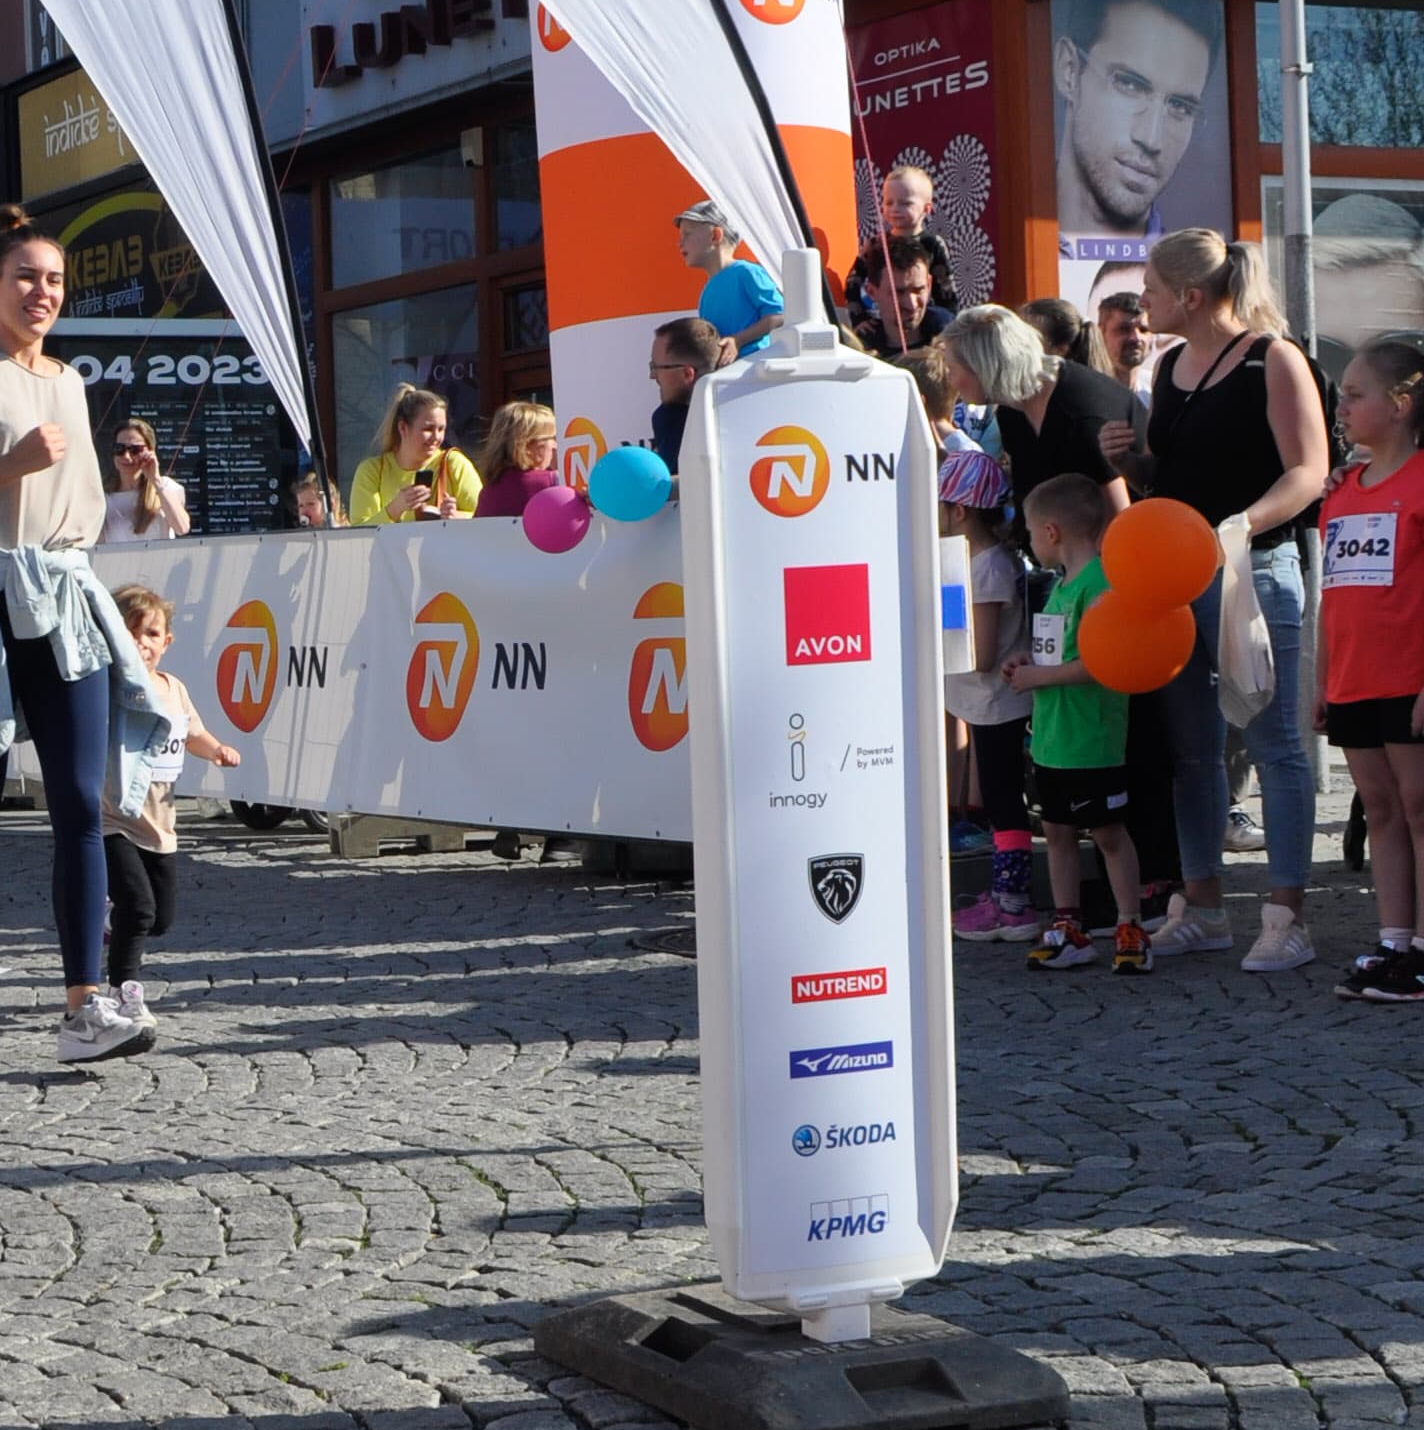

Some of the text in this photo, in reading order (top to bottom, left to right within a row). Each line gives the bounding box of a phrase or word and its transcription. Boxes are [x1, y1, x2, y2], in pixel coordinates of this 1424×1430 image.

[874, 37, 941, 66] OPTIKA
[853, 60, 989, 117] UNETTES
[1079, 244, 1148, 257] LINDB
[147, 355, 271, 386] 2023
[845, 451, 896, 483] NN
[1336, 538, 1390, 559] 3042
[795, 631, 862, 658] AVON
[287, 646, 328, 690] NN
[492, 642, 547, 692] NN
[857, 745, 894, 757] Powered
[857, 757, 893, 769] by MVM
[769, 792, 828, 809] innogy
[812, 858, 860, 869] PEUGEOT
[796, 973, 884, 998] NUTREND
[825, 1122, 896, 1149] ŠKODA
[807, 1210, 887, 1243] KPMG
